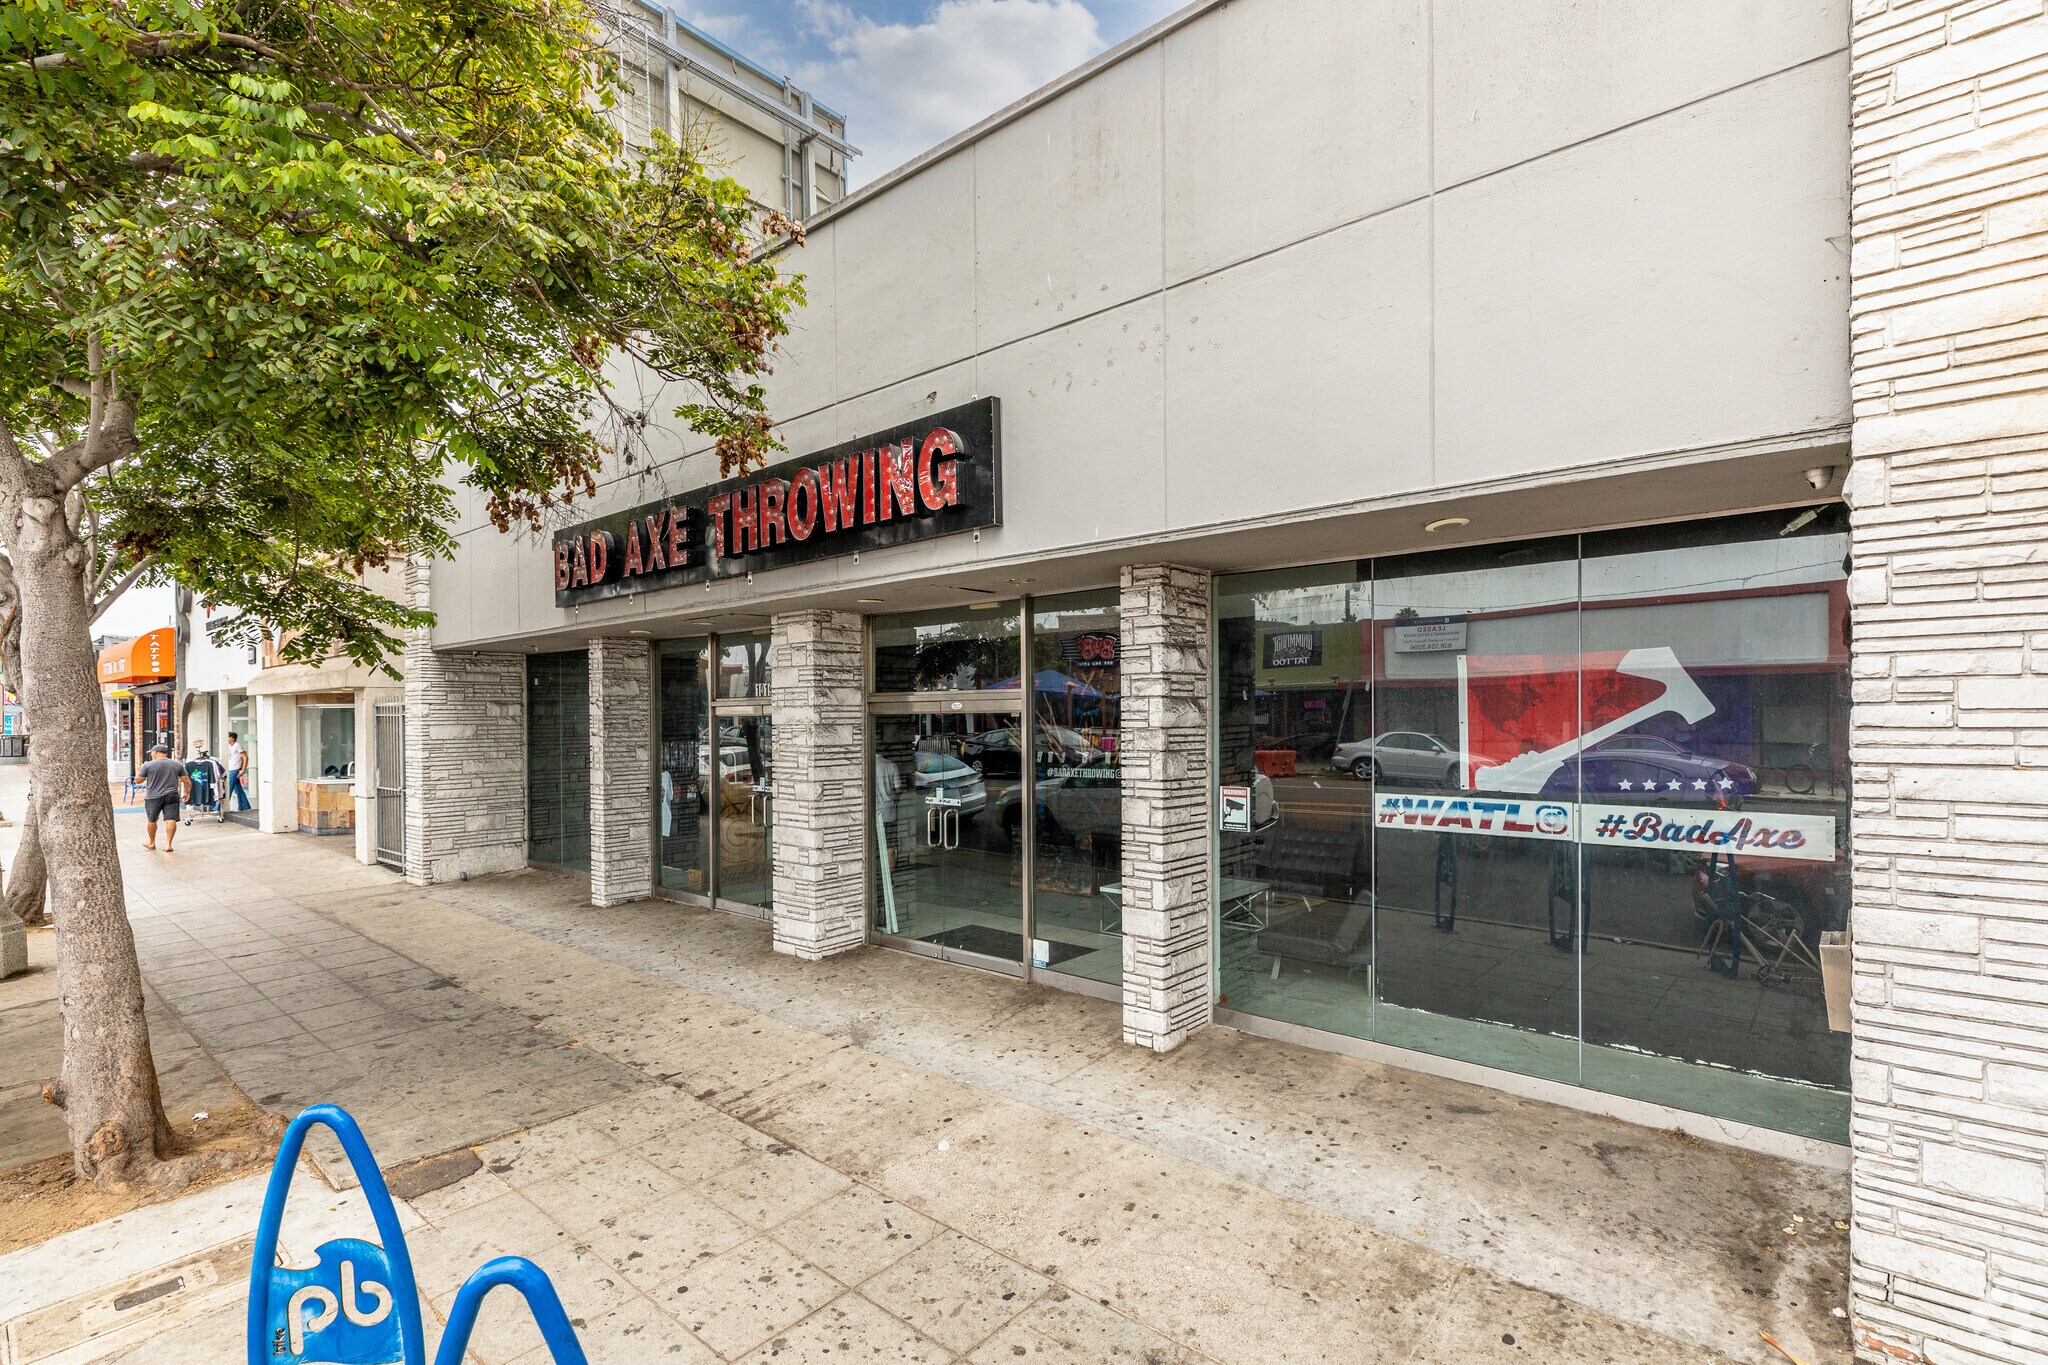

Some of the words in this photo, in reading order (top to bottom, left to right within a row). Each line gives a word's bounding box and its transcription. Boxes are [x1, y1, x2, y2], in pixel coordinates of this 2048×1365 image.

[554, 529, 612, 591] BAD
[623, 505, 693, 578] AXE
[708, 426, 962, 559] THROWING
[149, 634, 161, 673] TATTOO
[1379, 798, 1535, 832] #WATL
[1596, 812, 1806, 851] #BadAxe
